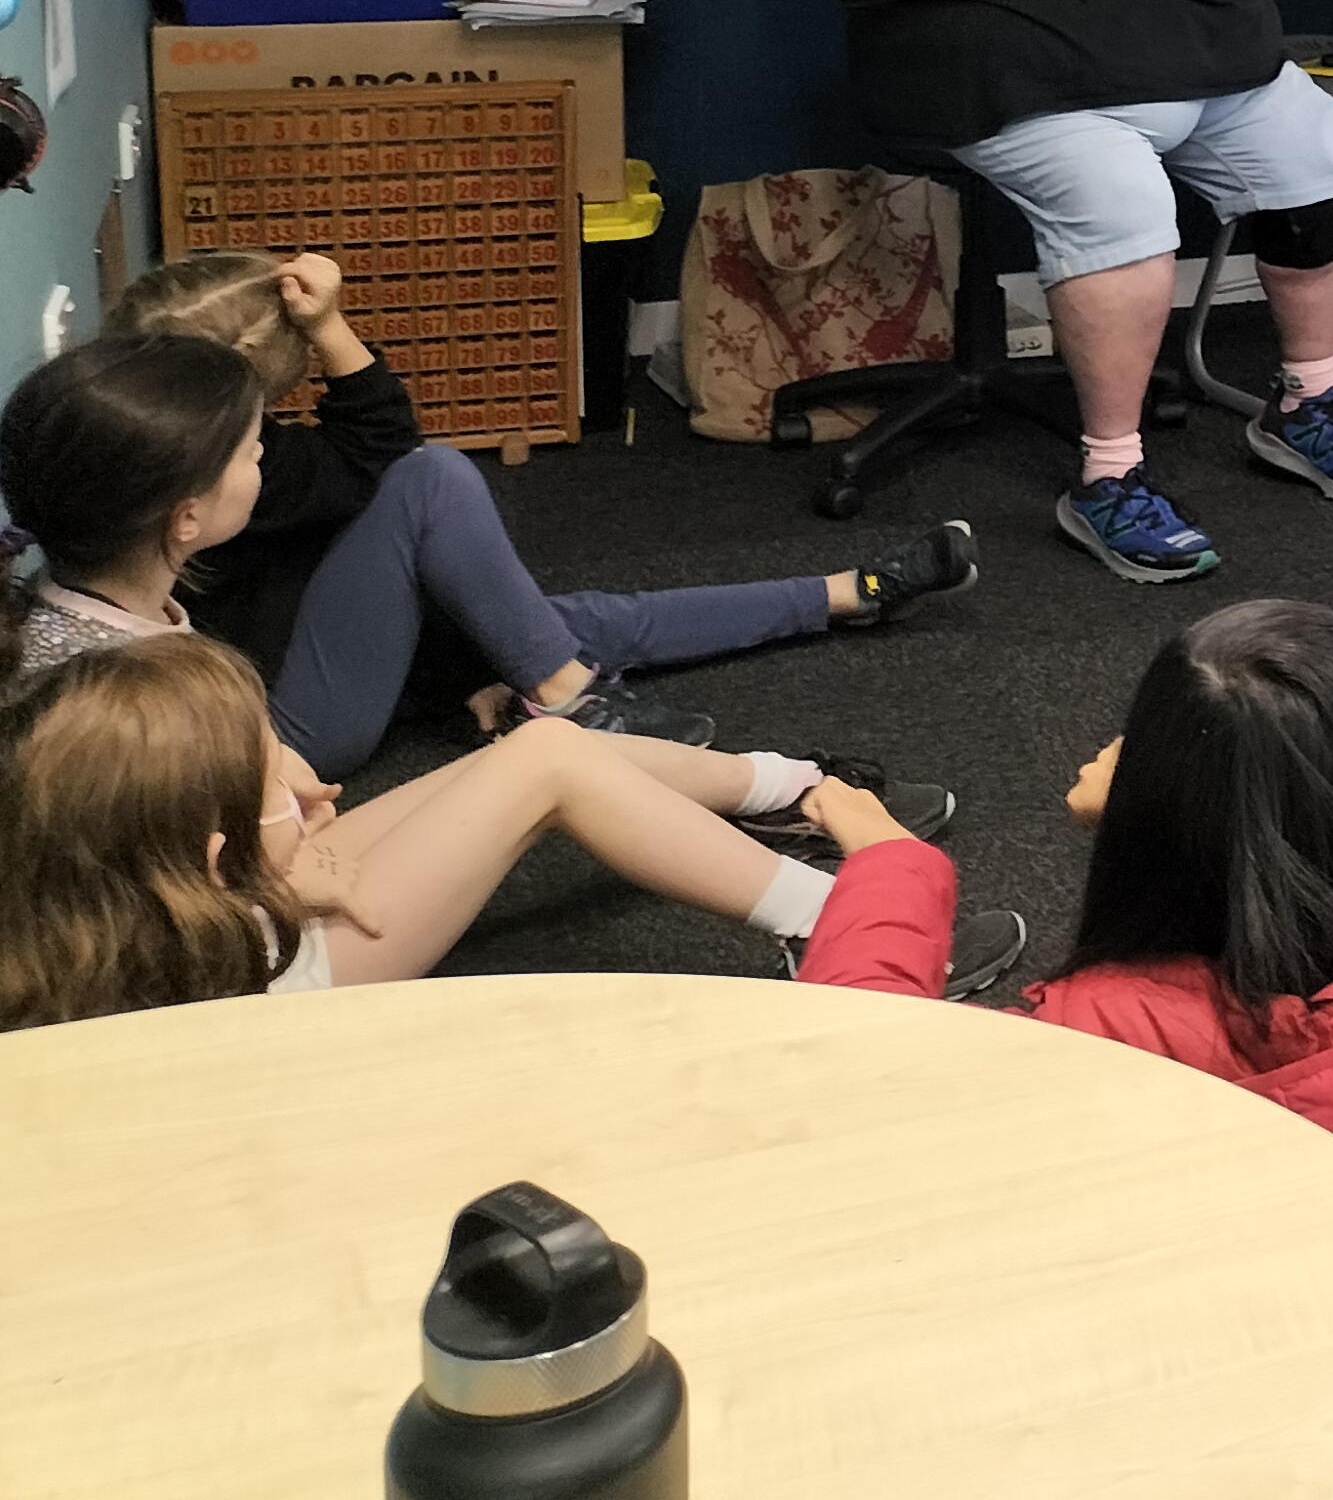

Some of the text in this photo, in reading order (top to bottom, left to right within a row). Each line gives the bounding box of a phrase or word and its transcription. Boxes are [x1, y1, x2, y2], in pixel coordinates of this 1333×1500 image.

[193, 126, 201, 142] 1
[234, 124, 246, 141] 2
[274, 122, 284, 139] 3
[308, 121, 321, 138] 4
[351, 120, 362, 137] 5
[386, 118, 400, 135] 6
[427, 117, 437, 134] 7
[500, 114, 512, 131] 9
[187, 147, 554, 177] 11 12 13 14 15 16 17 18 19 20
[188, 196, 212, 214] 21
[268, 193, 293, 209] 23
[306, 191, 330, 207] 24
[345, 188, 370, 205] 25
[382, 187, 408, 204] 26
[421, 185, 444, 202] 27
[458, 181, 482, 198] 28
[495, 181, 518, 198] 29
[531, 180, 554, 197] 30
[192, 214, 556, 246] 31 32 33 34 35 36 37 38 39 40
[350, 253, 371, 270] 45
[495, 248, 518, 263] 49
[531, 245, 556, 262] 50
[348, 287, 371, 305] 55
[384, 287, 407, 304] 56
[422, 285, 445, 302] 57
[458, 283, 481, 299] 58
[384, 319, 409, 336] 66
[421, 317, 444, 334] 67
[460, 314, 483, 331] 68
[496, 312, 519, 328] 69
[533, 310, 556, 327] 70
[422, 351, 445, 368] 77
[497, 346, 519, 362] 79
[497, 376, 519, 392] 89
